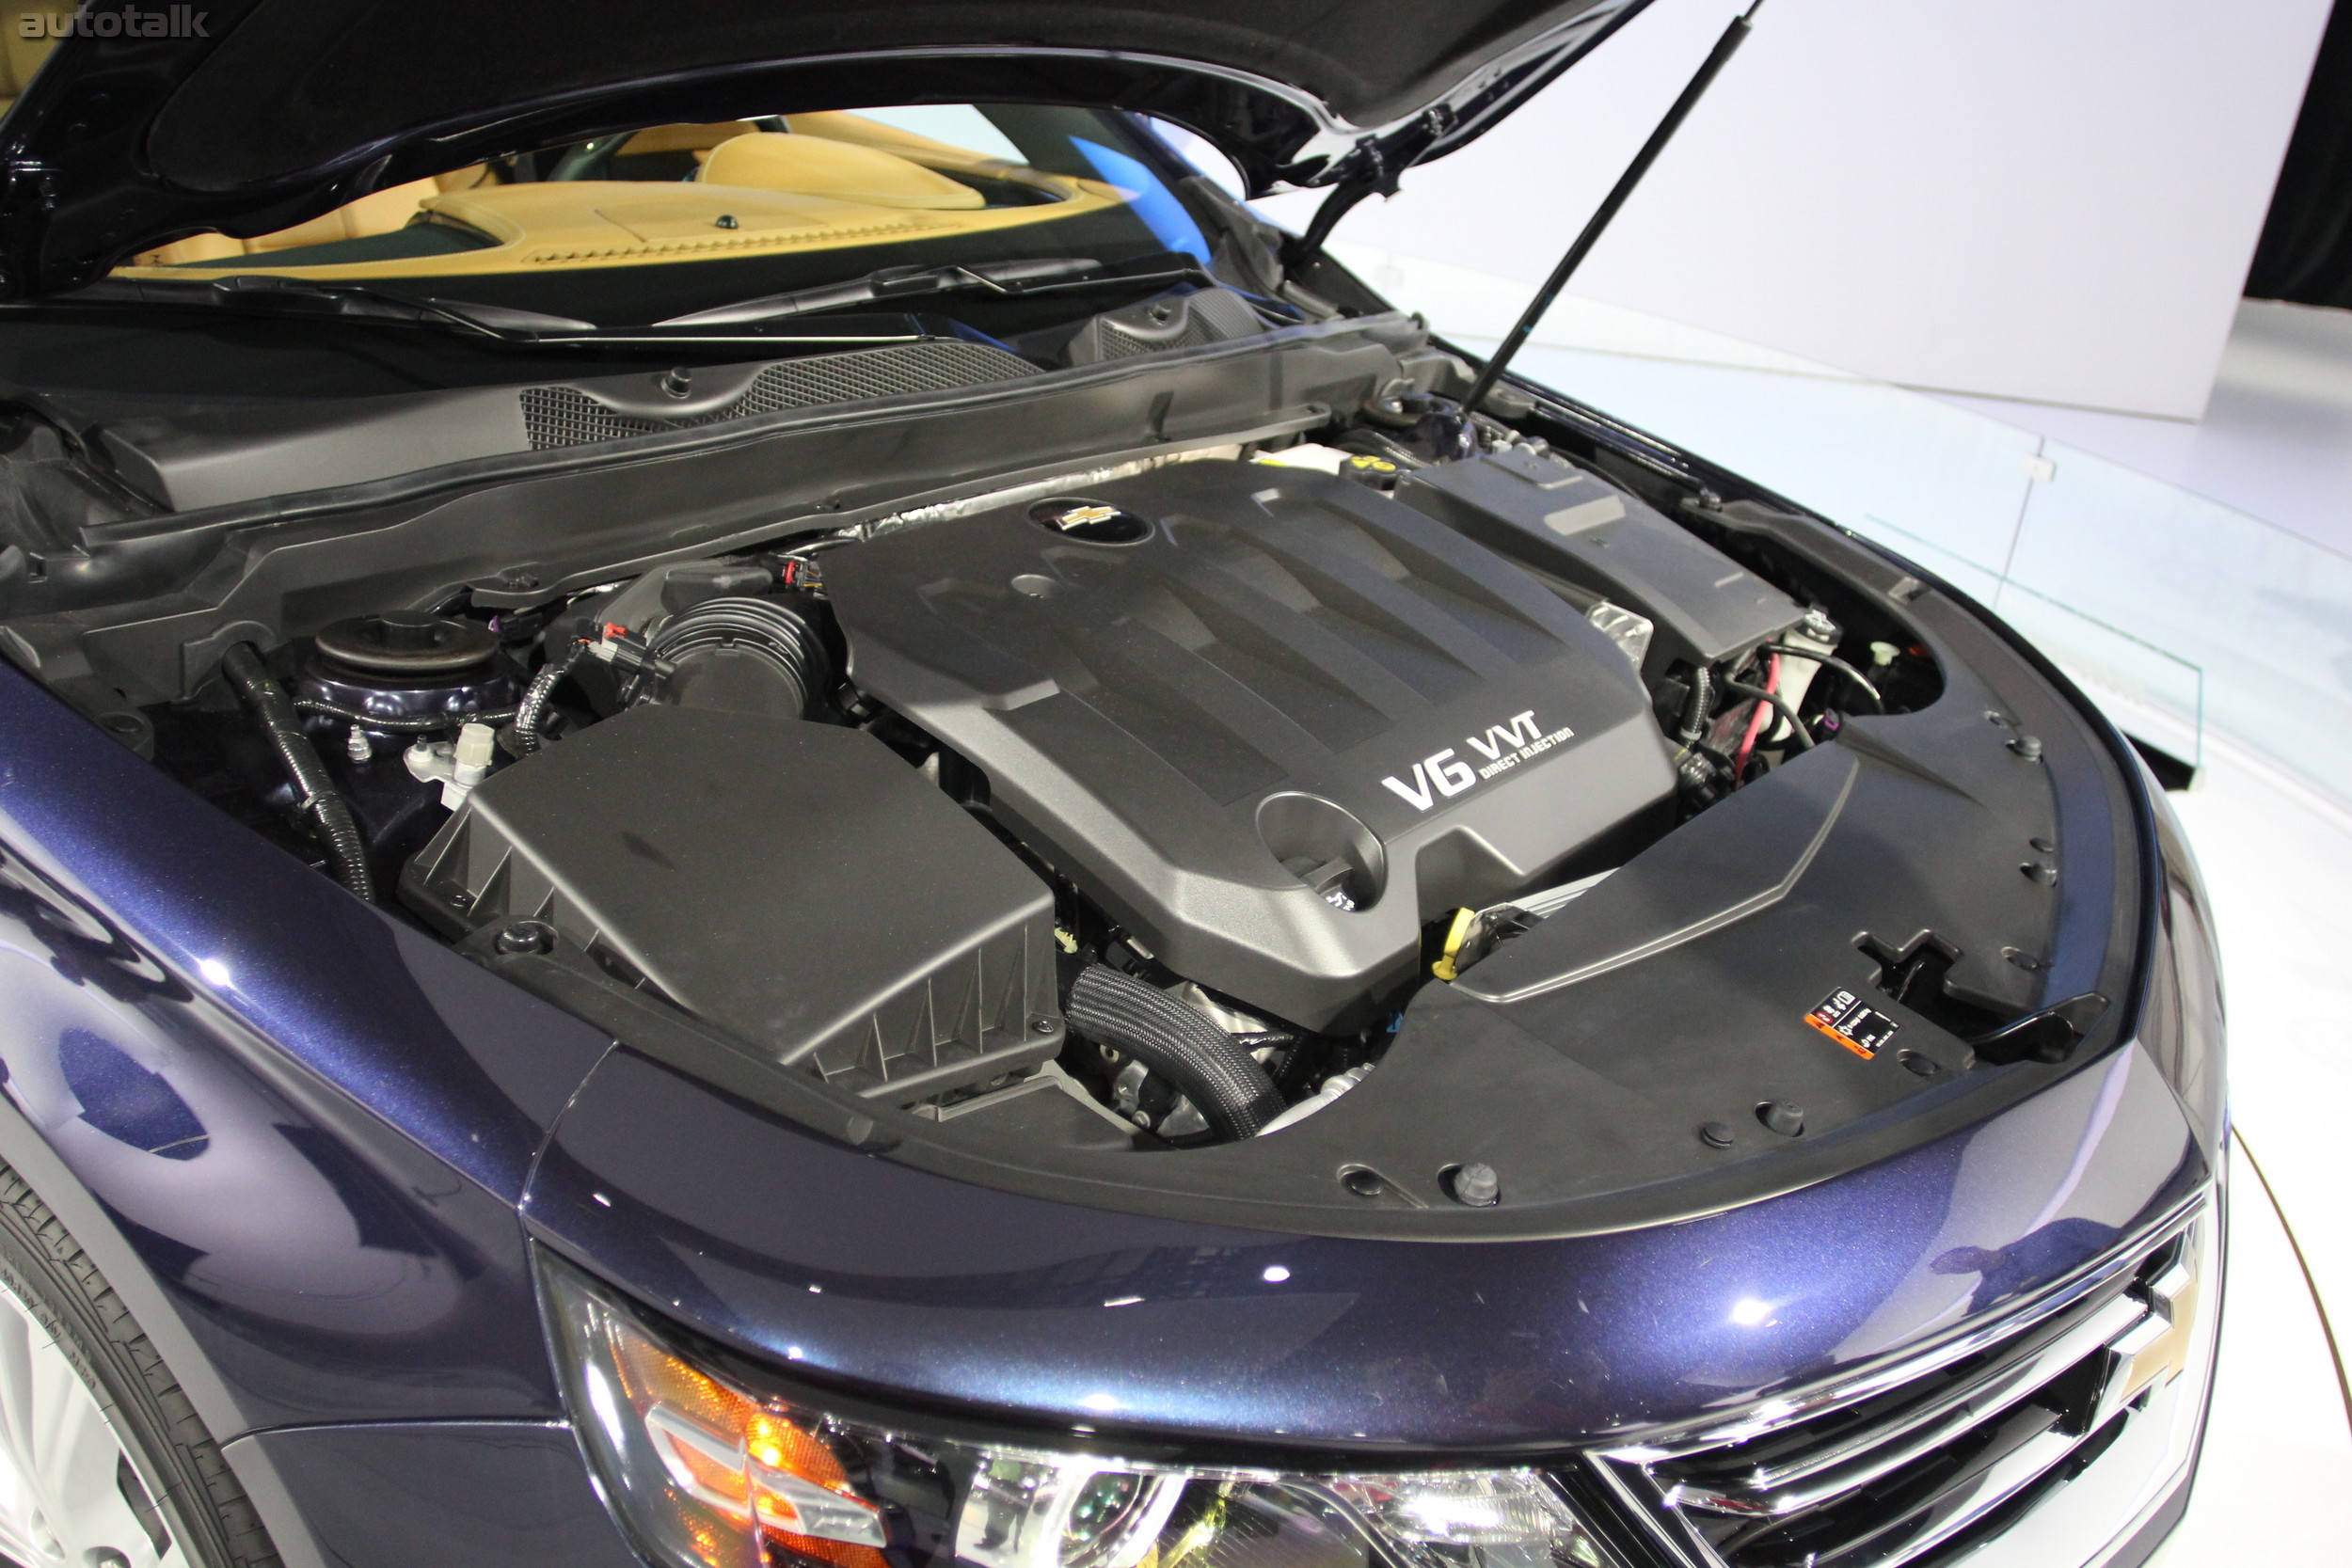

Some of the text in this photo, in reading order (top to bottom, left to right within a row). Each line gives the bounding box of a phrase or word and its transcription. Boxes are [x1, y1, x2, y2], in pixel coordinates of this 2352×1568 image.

[1381, 709, 1543, 813] V6 VVT
[1478, 726, 1575, 781] DIRECT INJECTION
